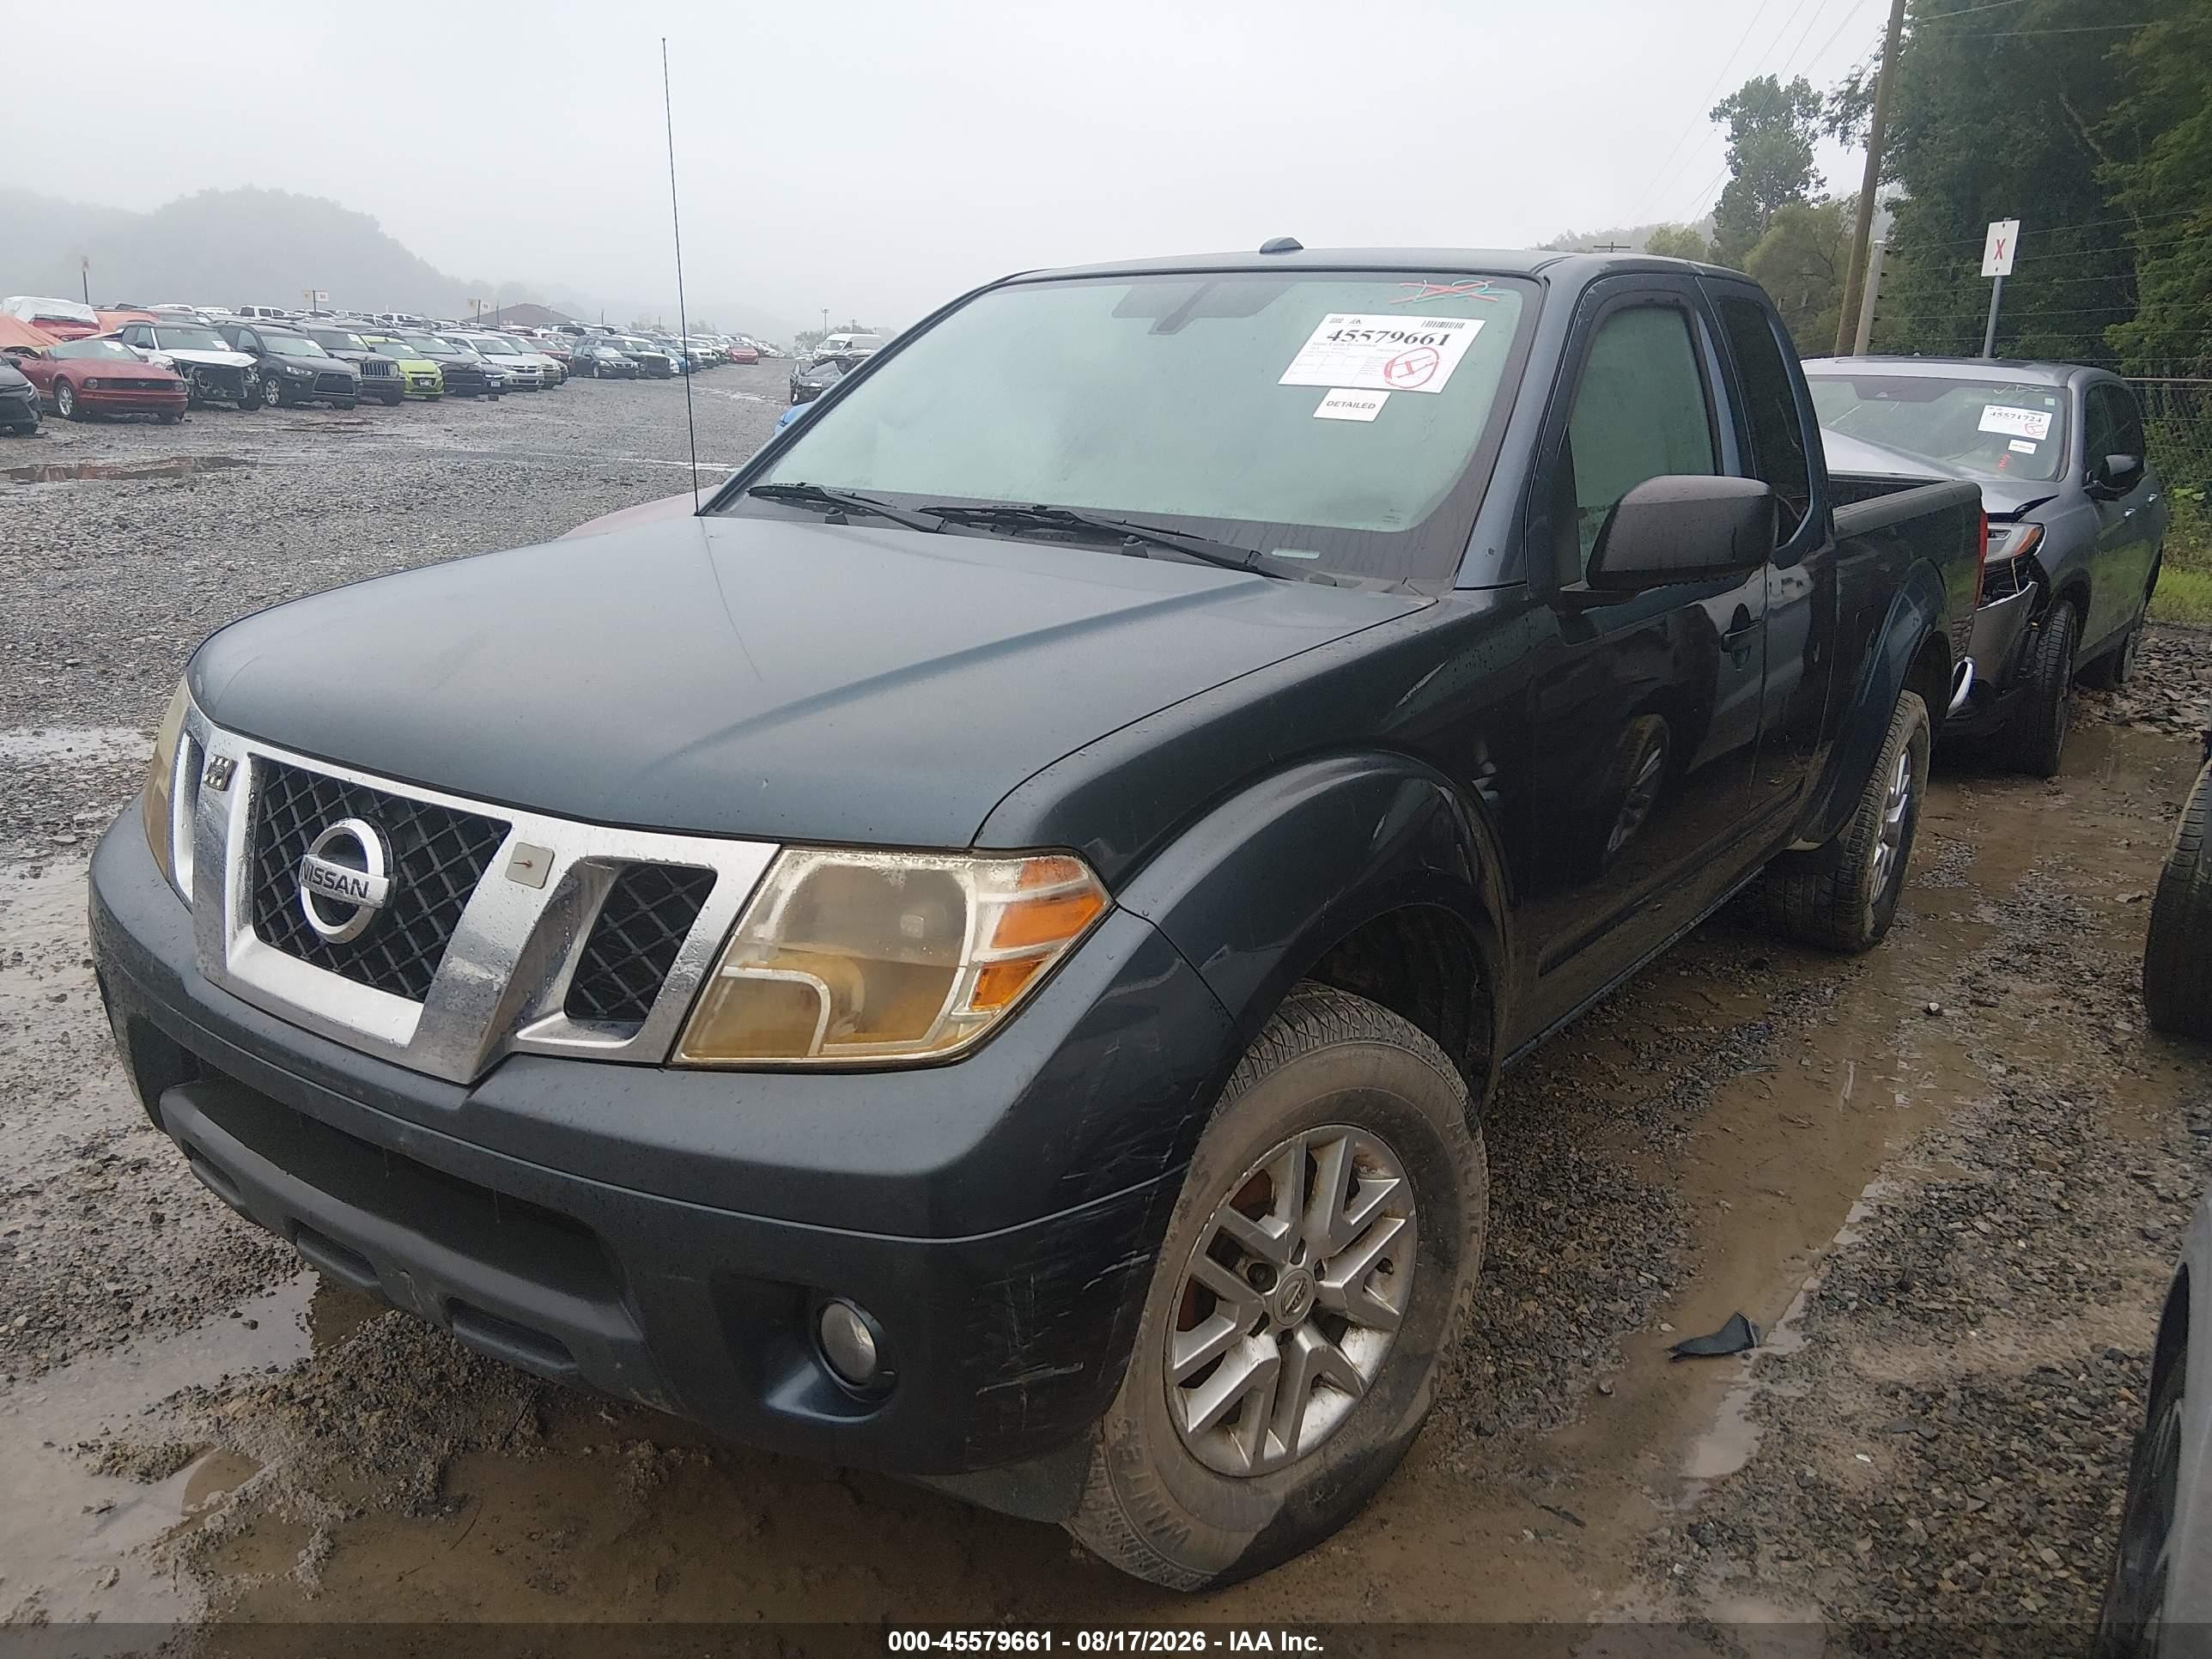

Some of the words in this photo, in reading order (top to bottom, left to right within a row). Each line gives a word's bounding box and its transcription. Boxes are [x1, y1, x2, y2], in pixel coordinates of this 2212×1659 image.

[1993, 238, 2007, 261] X
[1326, 329, 1451, 347] 45579661
[1326, 400, 1376, 410] DETAILED
[1989, 411, 2042, 422] 45571724
[301, 864, 369, 899] NISSAN
